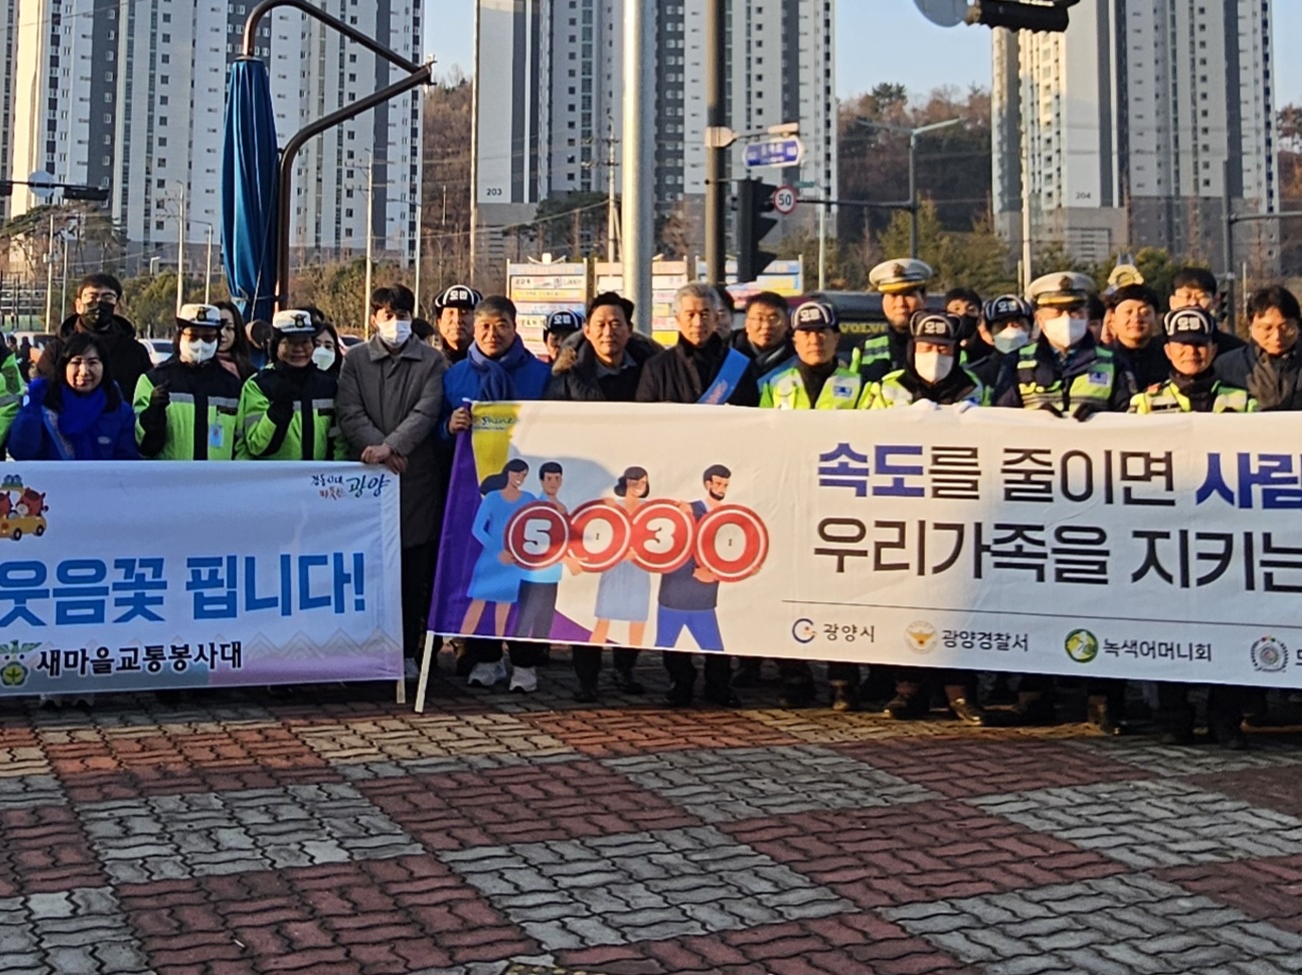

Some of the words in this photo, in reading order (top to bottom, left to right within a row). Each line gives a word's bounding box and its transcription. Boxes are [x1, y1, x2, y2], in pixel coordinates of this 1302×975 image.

[486, 188, 502, 196] 203
[779, 193, 792, 206] 50
[346, 473, 392, 498] 광양
[817, 442, 983, 502] 속도를
[1002, 447, 1175, 511] 줄이면
[812, 517, 1112, 586] 우리가족을
[185, 551, 366, 620] 핍니다!
[823, 623, 876, 644] 광양시
[941, 629, 1029, 652] 광양경찰서
[36, 641, 242, 677] 새마을교통봉사대
[1102, 638, 1213, 663] 녹색어머니회
